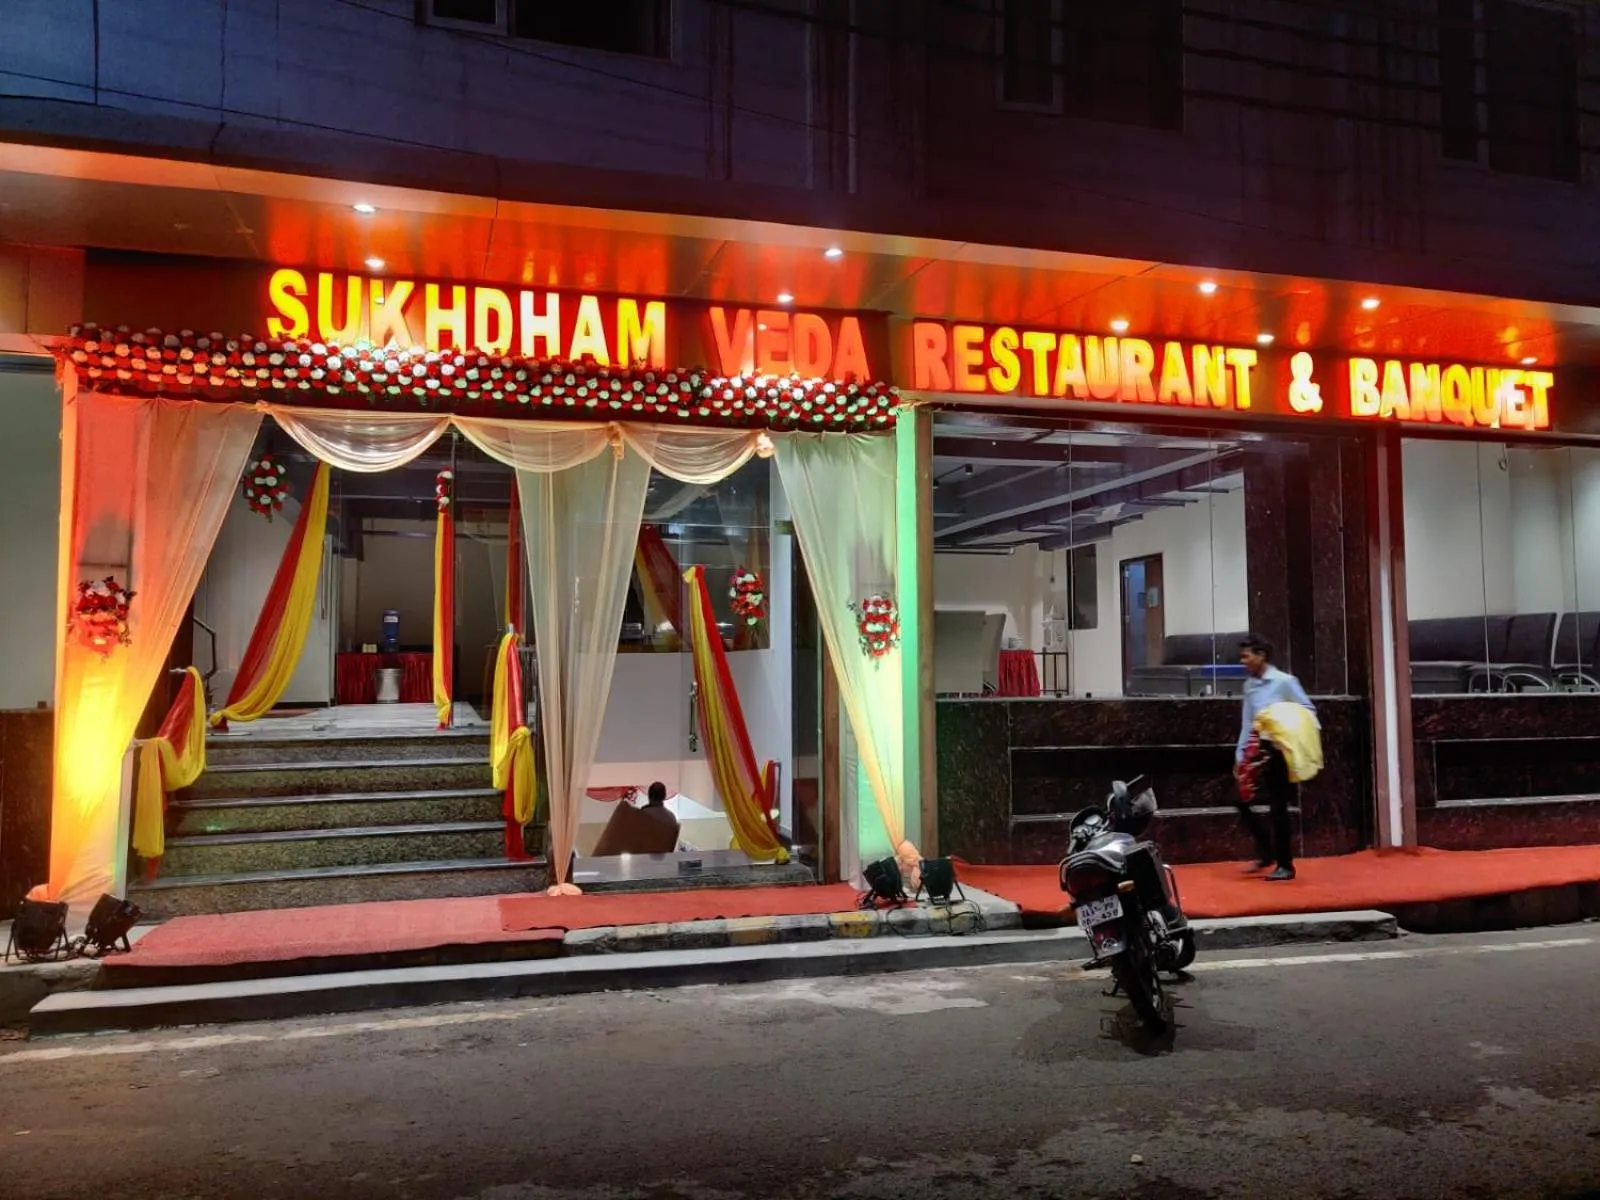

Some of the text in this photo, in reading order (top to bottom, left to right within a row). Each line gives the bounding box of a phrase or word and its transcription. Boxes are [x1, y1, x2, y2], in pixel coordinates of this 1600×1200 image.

[266, 268, 1554, 430] SUKHDHAM VEDA RESTAURANT & BANQUET
